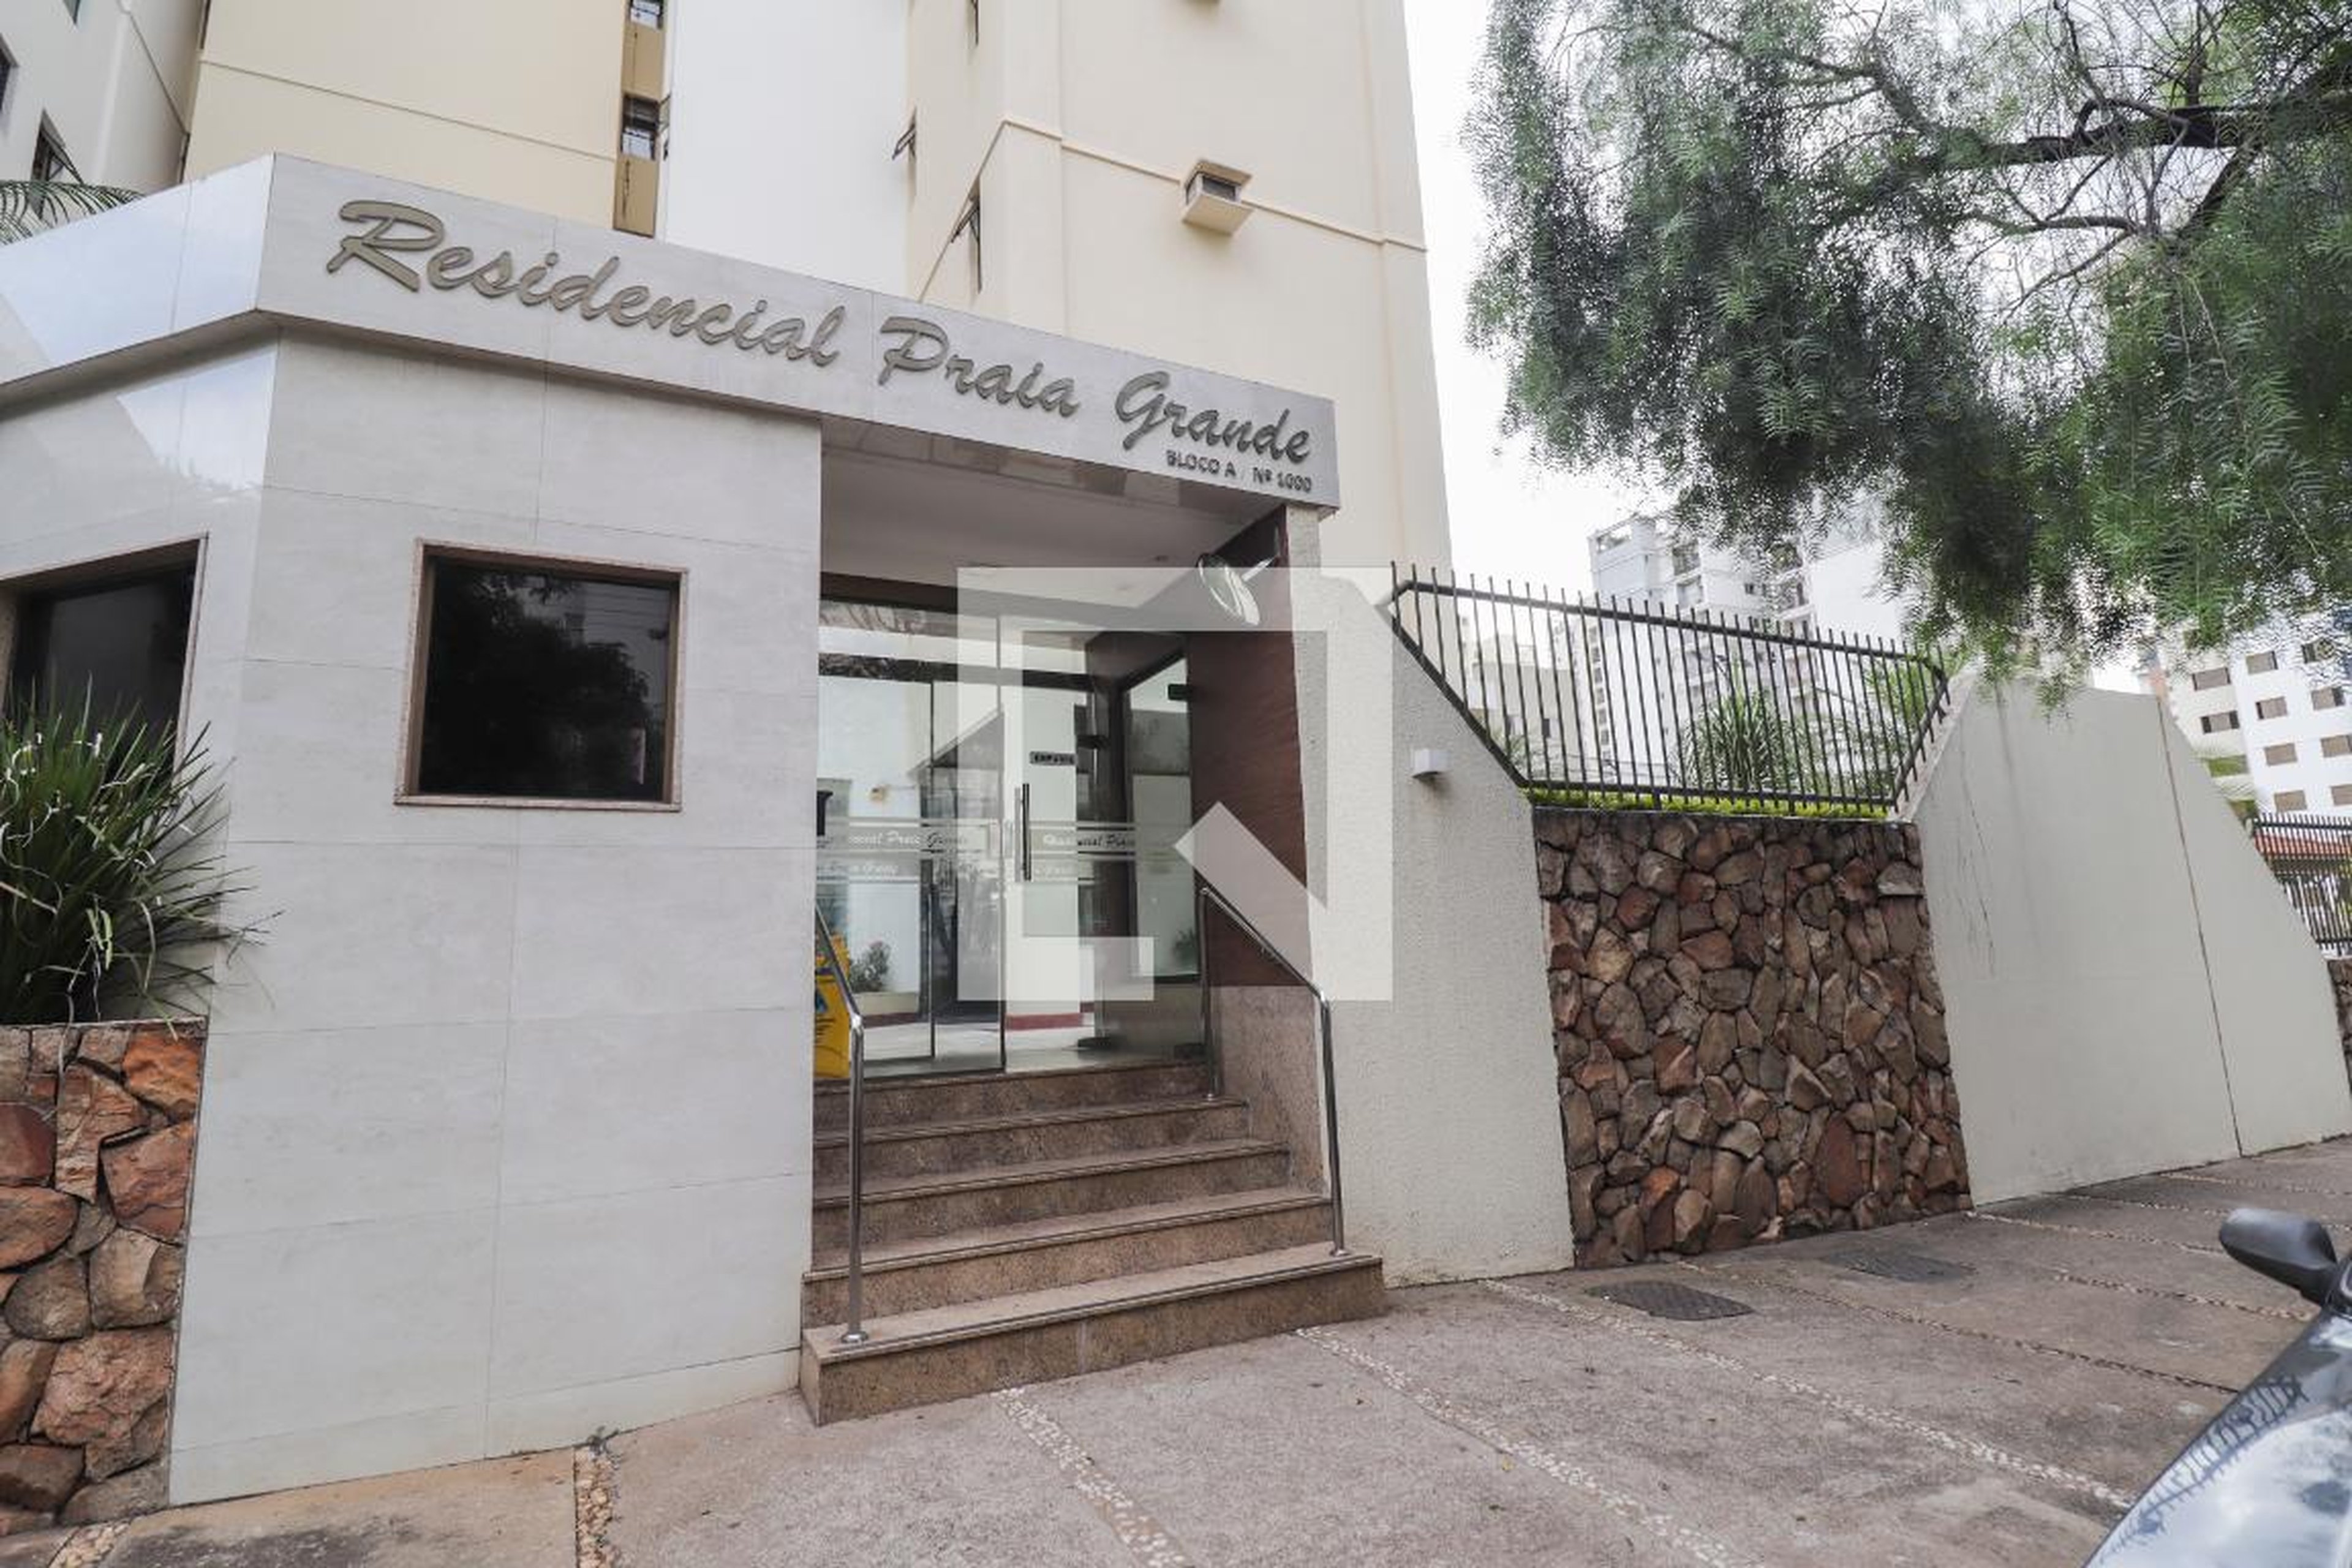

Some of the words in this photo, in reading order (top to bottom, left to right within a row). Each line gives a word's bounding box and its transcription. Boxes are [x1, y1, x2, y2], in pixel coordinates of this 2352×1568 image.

[326, 199, 845, 366] Residencial
[877, 315, 1080, 418] Praia
[1115, 371, 1311, 464] Grande
[1166, 450, 1219, 474] BLOCO
[1225, 461, 1236, 477] A
